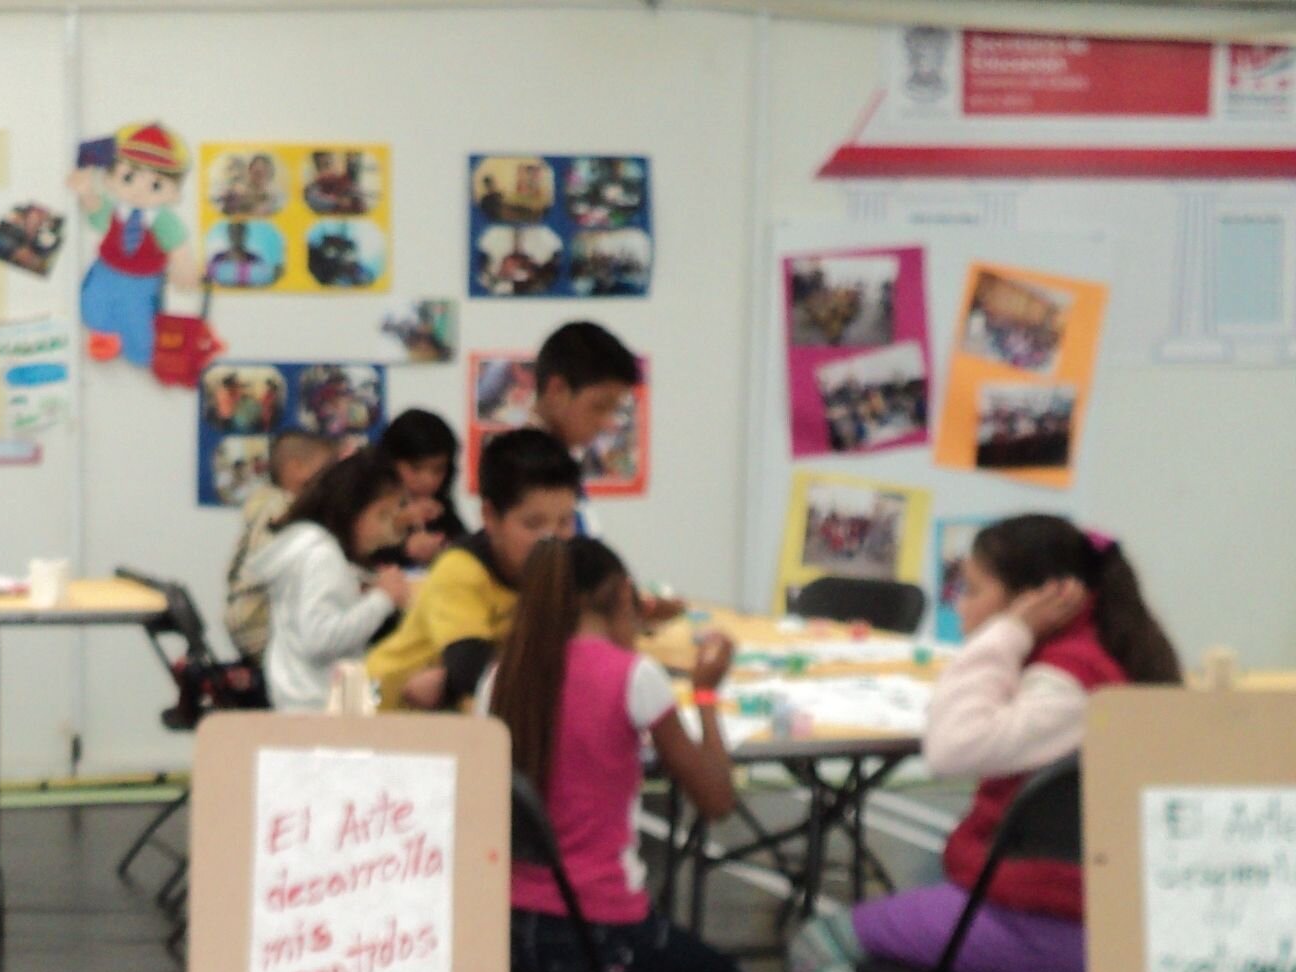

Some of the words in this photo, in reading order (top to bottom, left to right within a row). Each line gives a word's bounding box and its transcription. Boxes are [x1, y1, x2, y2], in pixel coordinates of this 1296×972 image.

[267, 805, 311, 856] El
[336, 790, 415, 851] Arte
[265, 831, 444, 912] desarrolla
[262, 920, 334, 971] mis
